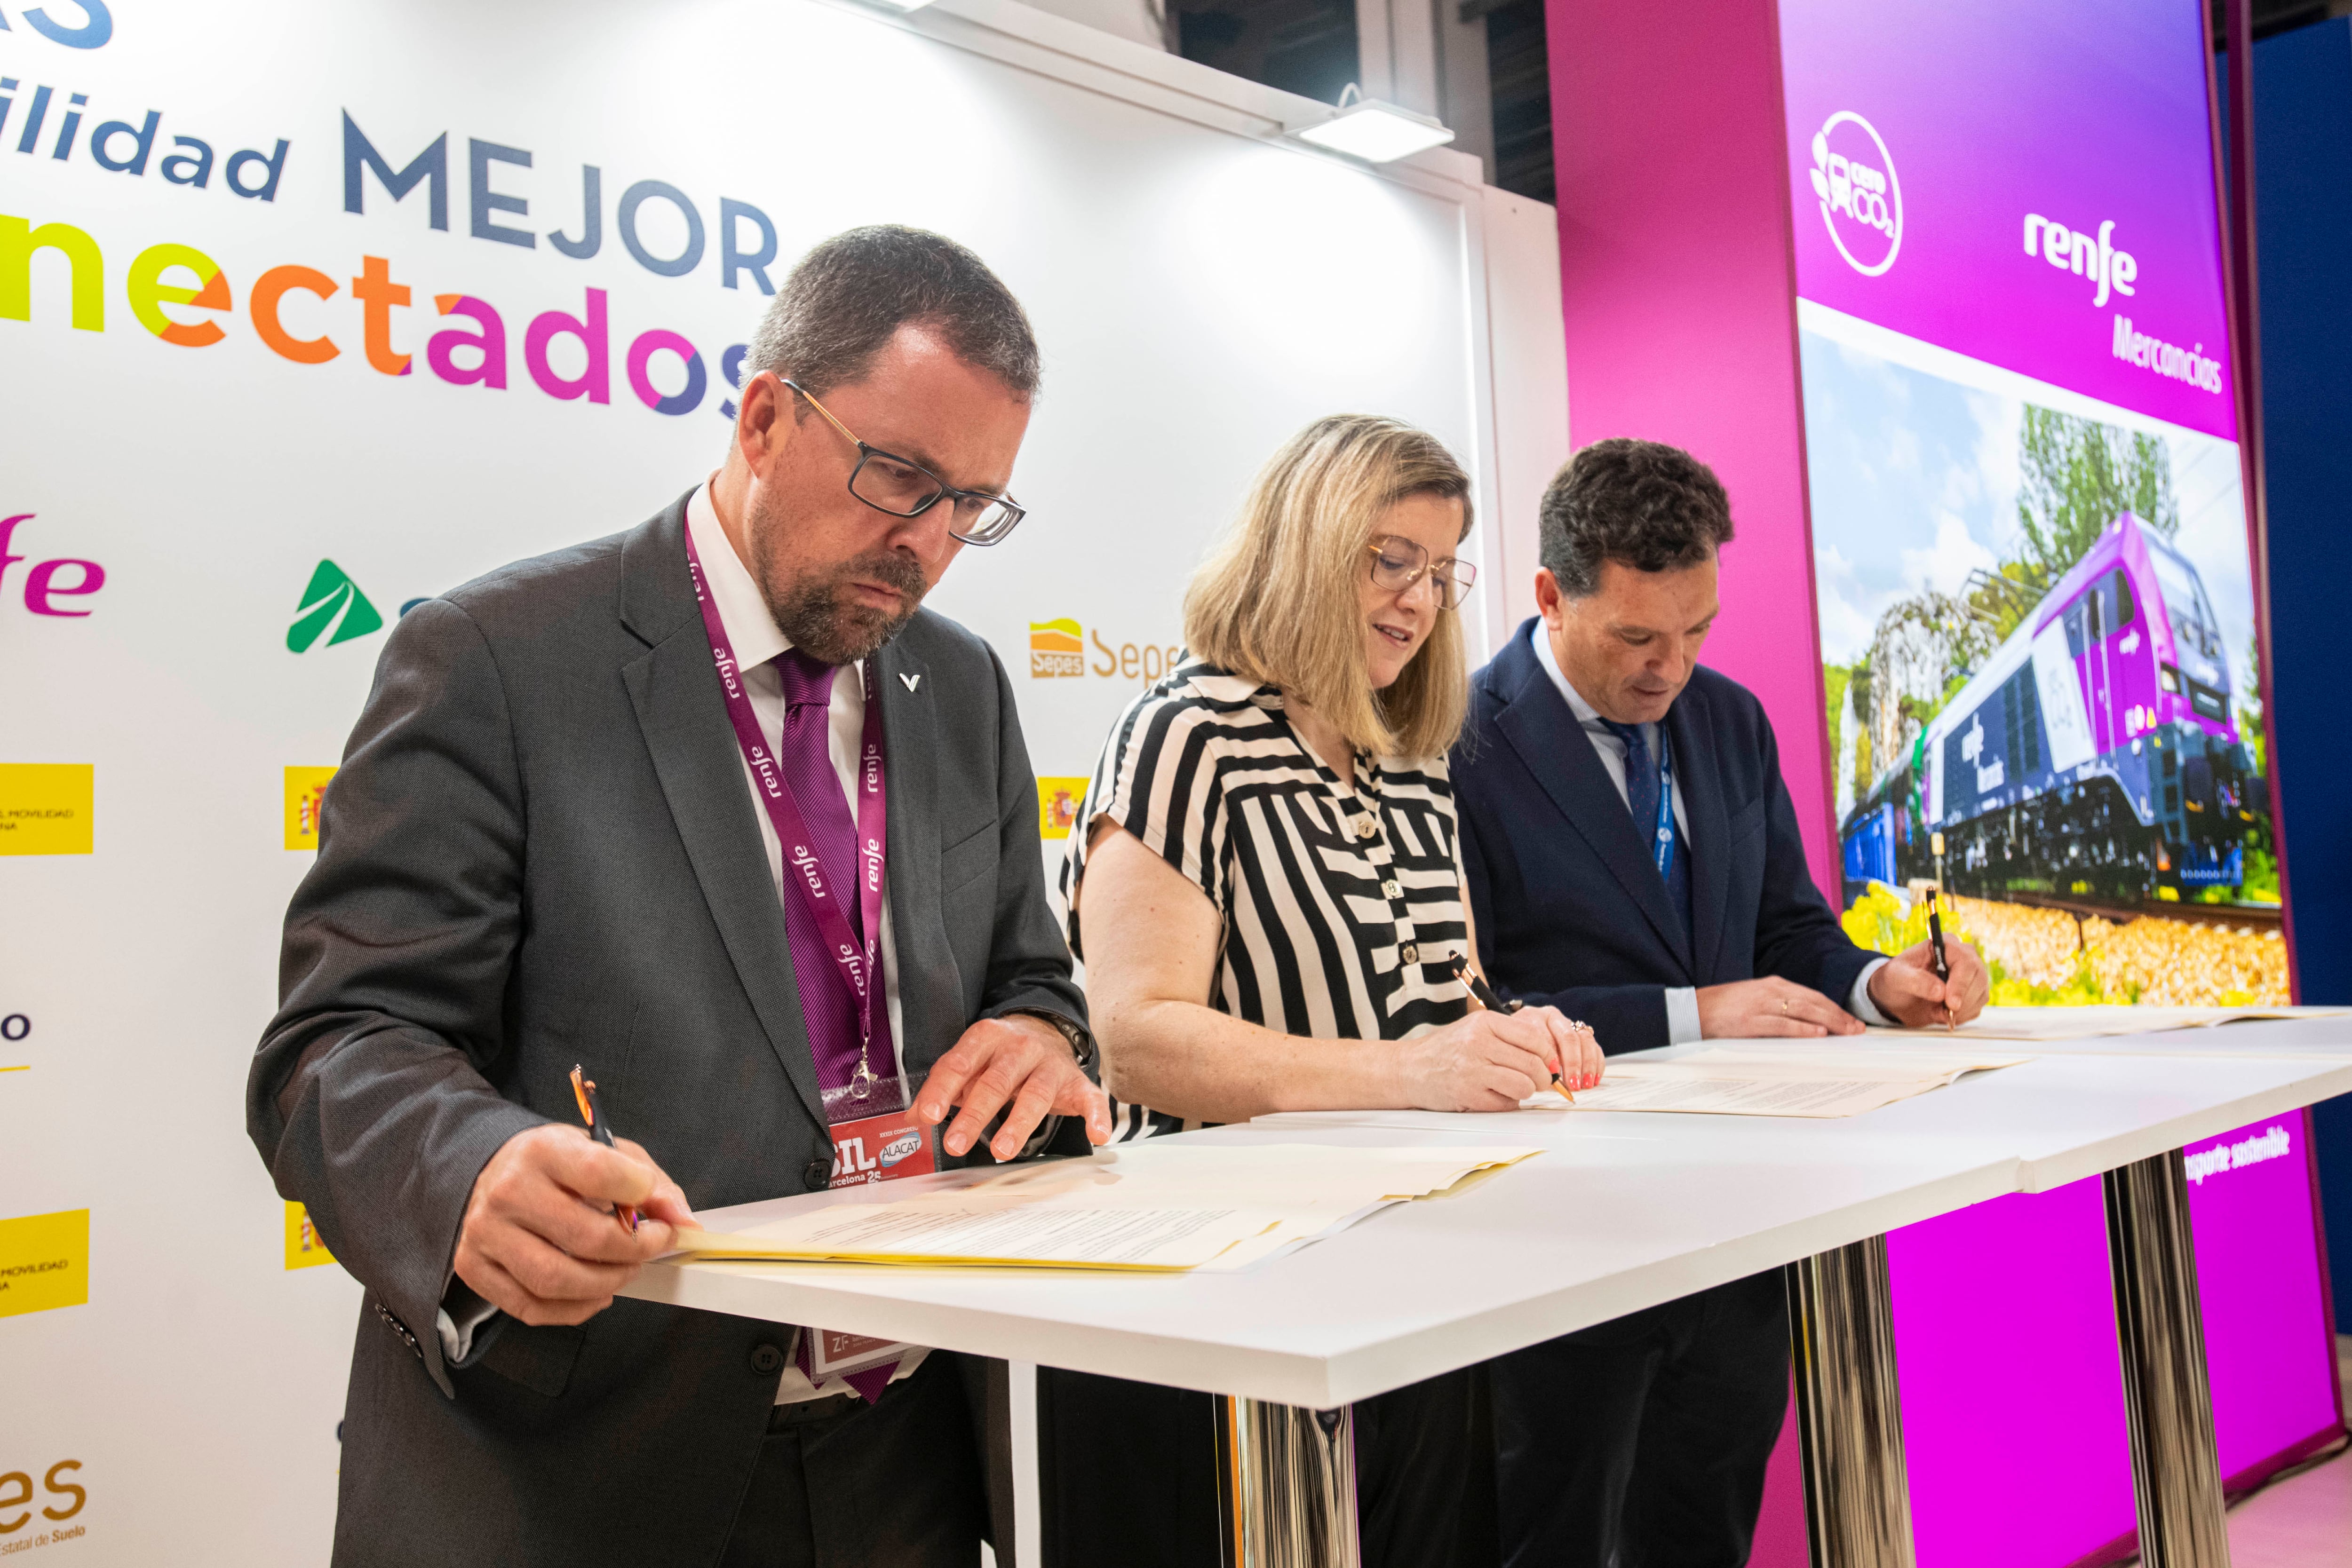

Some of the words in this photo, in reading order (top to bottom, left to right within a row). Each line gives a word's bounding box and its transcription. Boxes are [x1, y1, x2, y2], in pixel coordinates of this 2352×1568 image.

[342, 106, 777, 296] MEJOR
[2024, 213, 2137, 308] renfe
[714, 647, 740, 698] renfe
[1033, 655, 1083, 677] Sepes
[750, 746, 782, 798] renfe
[863, 744, 882, 792] renfe
[9, 809, 74, 819] MOVILIDAD
[792, 845, 826, 898] renfe
[862, 839, 884, 892] renfe
[838, 943, 866, 996] renfe
[0, 1013, 32, 1041] o
[882, 1140, 919, 1159] ALACAT
[893, 1126, 919, 1135] CONGRESO
[0, 1259, 69, 1276] MOVILIDAD
[832, 1335, 849, 1353] ZF
[0, 1459, 87, 1534] es
[35, 1533, 49, 1547] de
[52, 1525, 86, 1543] Suelo
